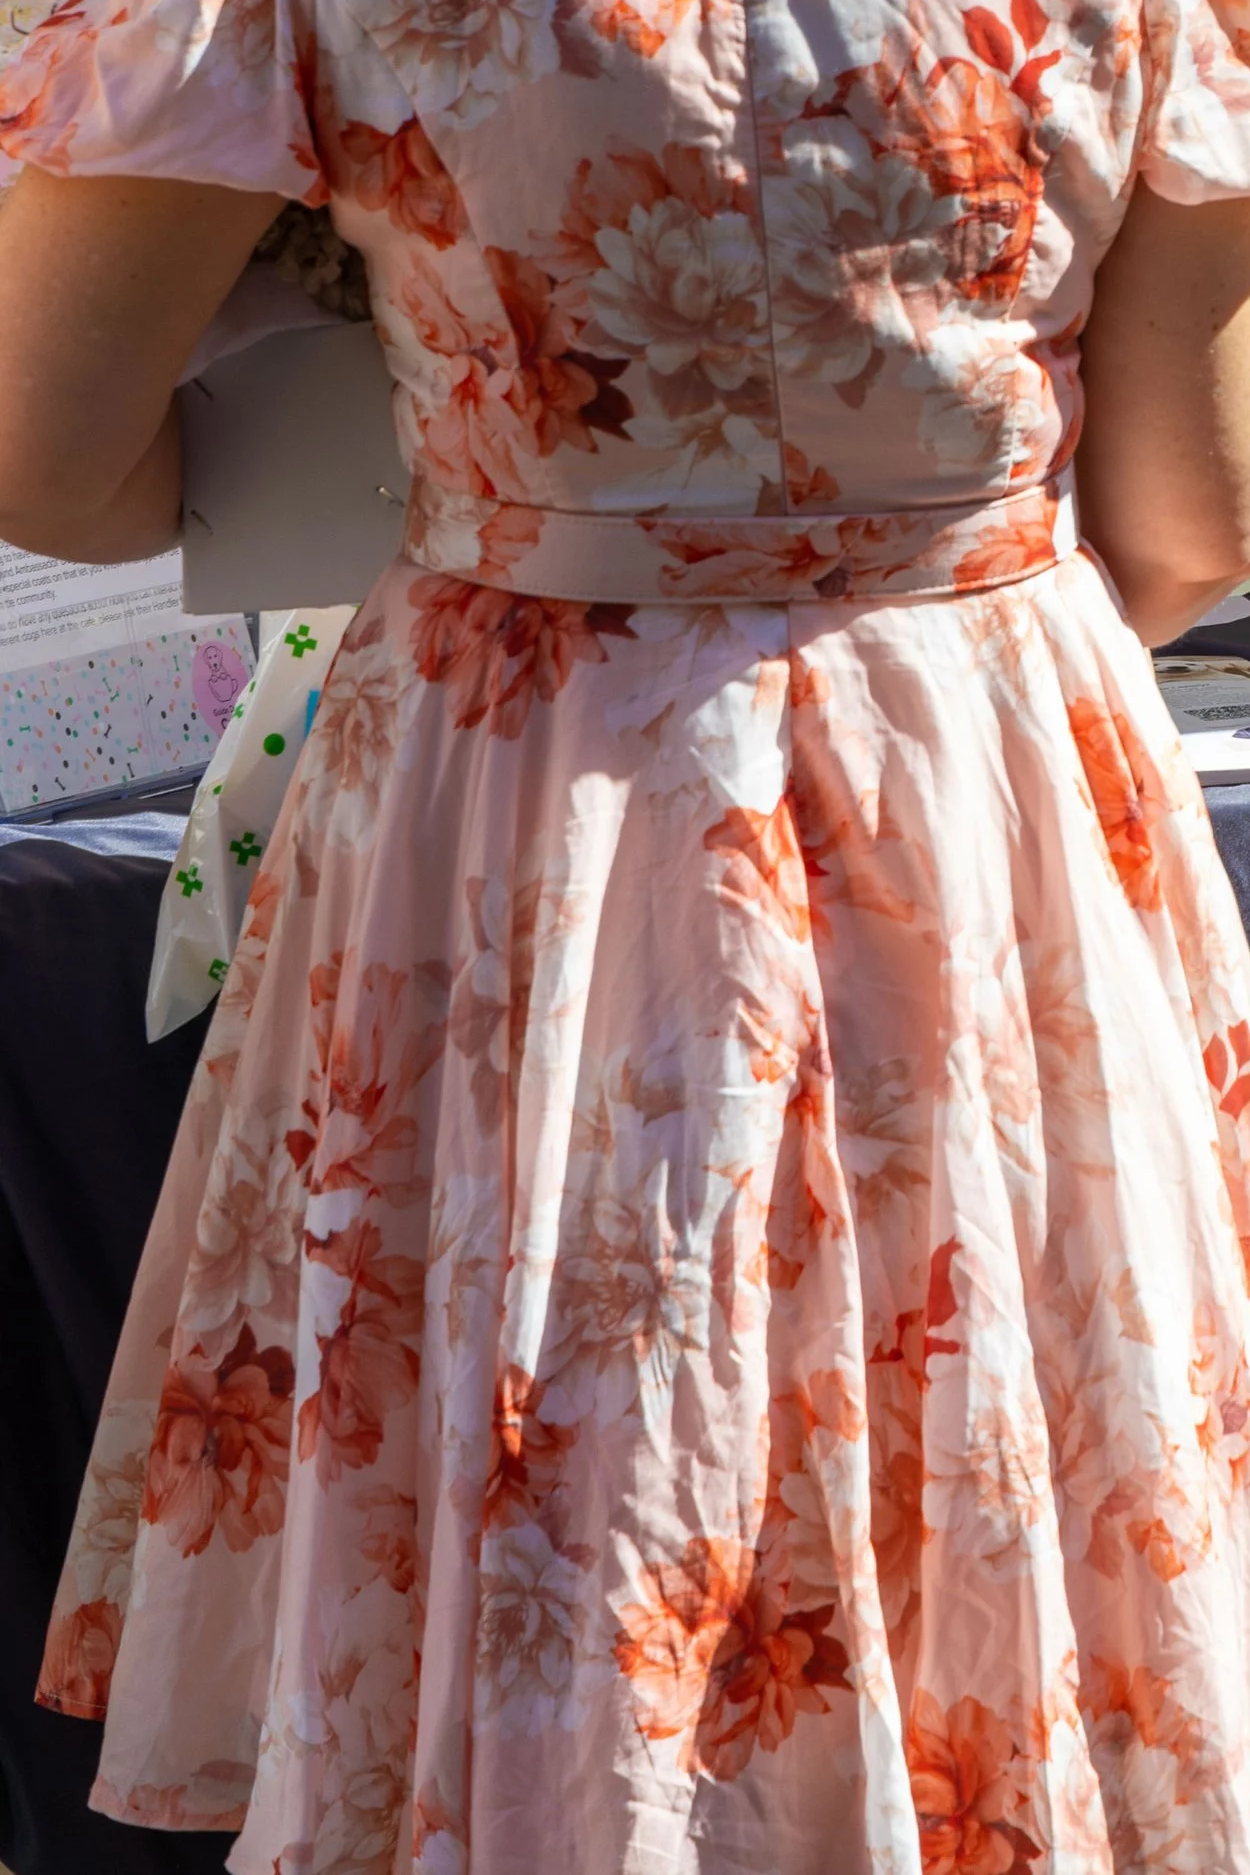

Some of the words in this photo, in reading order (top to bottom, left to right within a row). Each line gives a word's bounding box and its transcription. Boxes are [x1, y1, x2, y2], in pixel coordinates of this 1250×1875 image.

[15, 559, 58, 575] Ambassador
[32, 575, 52, 587] coats
[53, 572, 62, 582] on
[63, 568, 78, 580] that
[78, 565, 88, 577] let
[89, 564, 103, 576] you
[17, 589, 57, 606] community.
[21, 629, 41, 642] dogs
[41, 625, 58, 637] here
[98, 611, 122, 625] please
[136, 604, 152, 615] their
[153, 597, 180, 611] Handler
